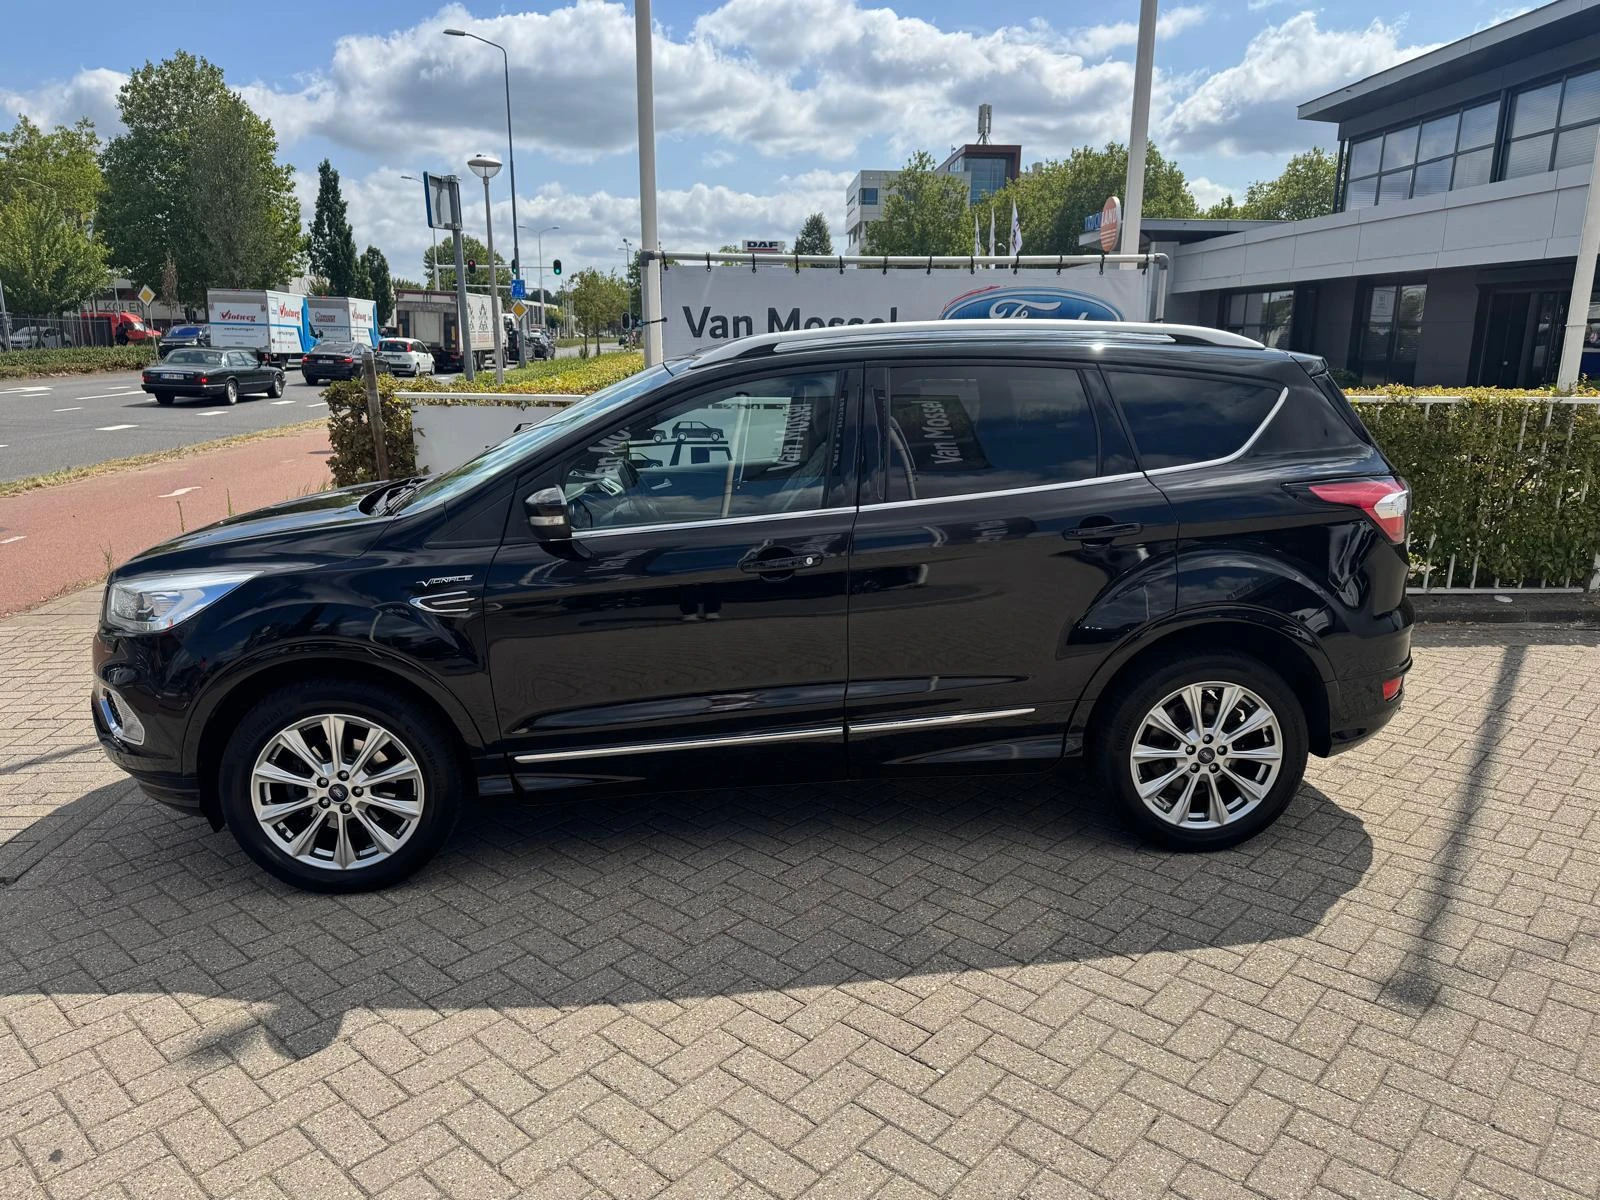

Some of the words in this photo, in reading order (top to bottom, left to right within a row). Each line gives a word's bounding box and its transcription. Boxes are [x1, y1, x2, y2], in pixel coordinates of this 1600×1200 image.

[682, 306, 753, 338] Van
[767, 307, 898, 333] Mol
[911, 400, 955, 439] Mossel
[931, 442, 964, 464] Van
